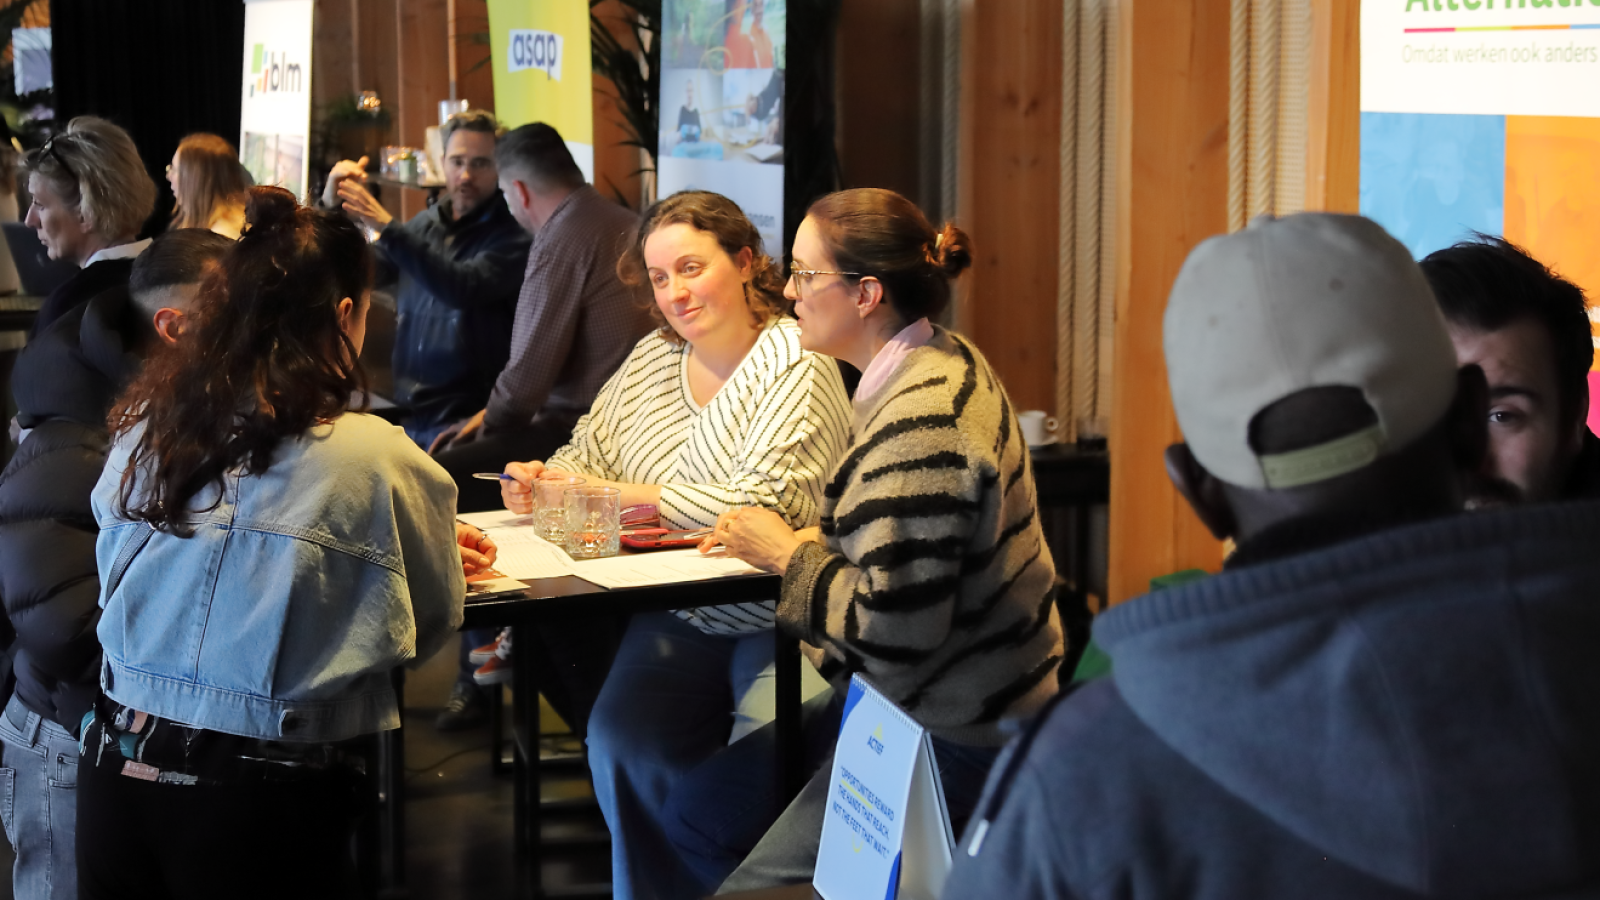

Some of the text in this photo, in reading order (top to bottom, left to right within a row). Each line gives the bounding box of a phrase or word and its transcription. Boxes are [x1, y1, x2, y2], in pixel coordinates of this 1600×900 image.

[513, 33, 557, 80] asap
[1402, 40, 1598, 63] Omdat werken ook anders
[838, 784, 847, 800] THE
[846, 791, 860, 814] HANDS
[861, 805, 873, 824] THAT
[874, 796, 894, 821] REWARD
[842, 808, 850, 825] THE
[861, 827, 873, 846] THAT
